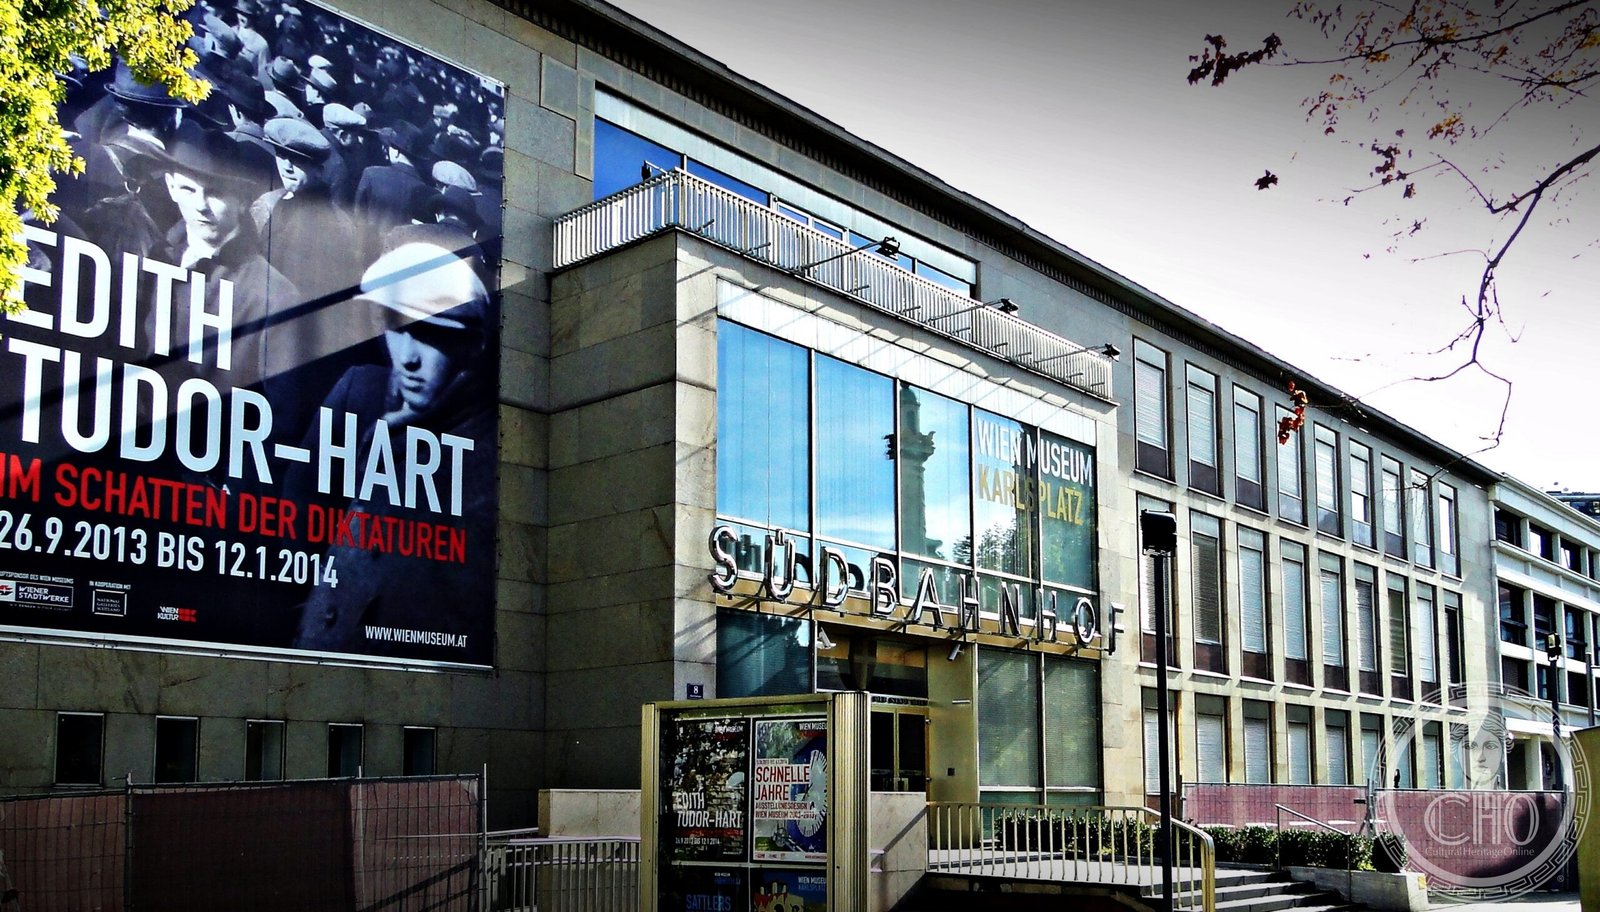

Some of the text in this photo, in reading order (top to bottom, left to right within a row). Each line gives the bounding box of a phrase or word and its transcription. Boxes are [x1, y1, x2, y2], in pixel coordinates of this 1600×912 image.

[6, 224, 234, 370] EDITH
[8, 337, 475, 516] TUDOR-HART
[976, 418, 1093, 488] WIEN MUSEUM
[977, 463, 1084, 526] KARLSPLATZ
[0, 453, 466, 564] IM SCHATTEN DER DIKTATUREN
[0, 510, 338, 588] 26.9.2013 BIS 12.1.2014
[18, 592, 70, 603] STADTWERKE
[19, 586, 49, 595] WIENER
[708, 525, 1126, 656] SÜDBAHNHOF
[157, 612, 179, 621] KULTUR
[160, 606, 179, 614] WIEN
[365, 625, 468, 648] WWW.WIENMUSEUM.AT
[694, 685, 699, 695] 8
[756, 766, 810, 783] SCHNELLE
[676, 792, 705, 809] EDITH
[755, 785, 789, 801] JAHRE
[686, 894, 731, 911] SATTLERS
